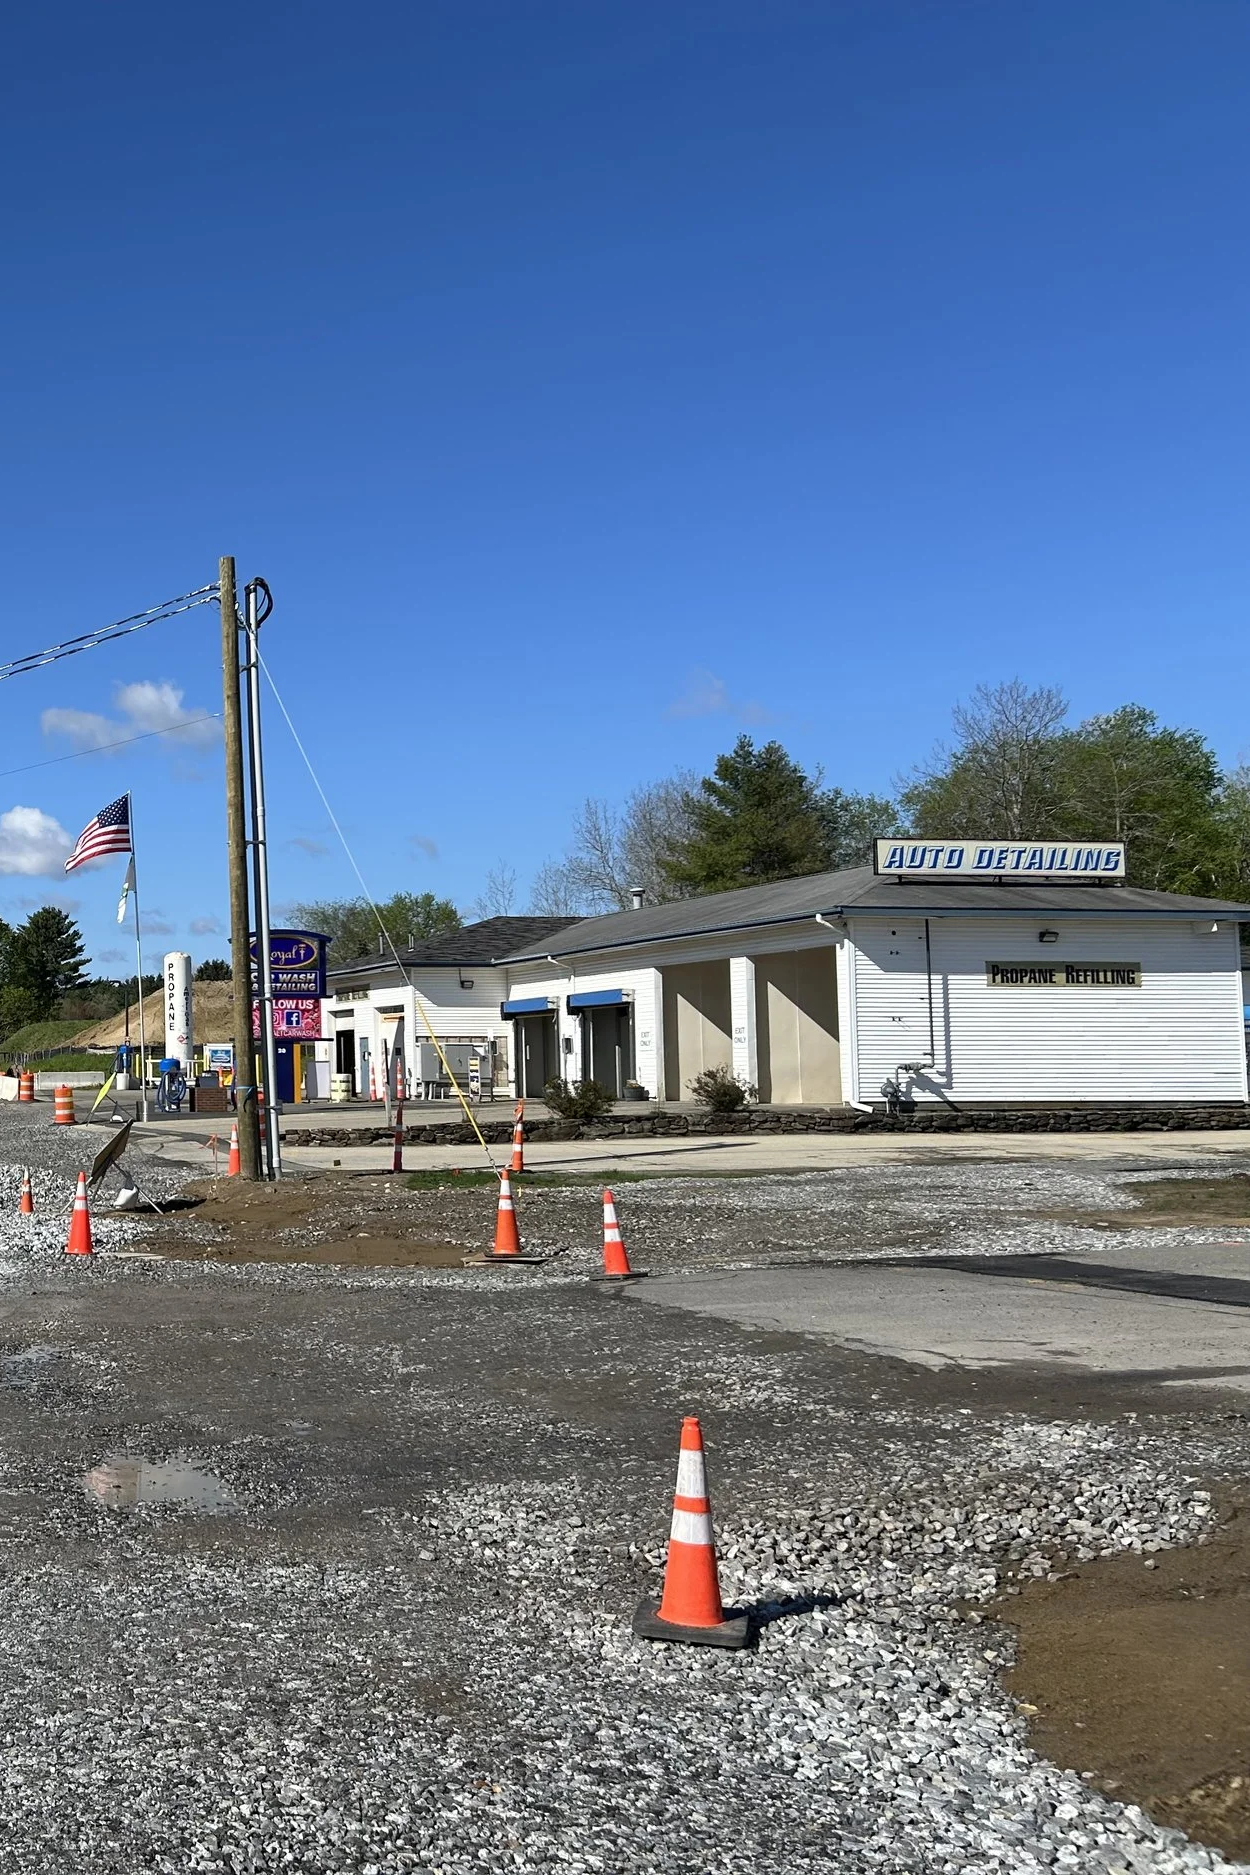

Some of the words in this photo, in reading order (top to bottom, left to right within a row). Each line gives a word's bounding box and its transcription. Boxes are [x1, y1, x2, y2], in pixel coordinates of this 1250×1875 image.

[883, 845, 964, 869] AUTO
[972, 845, 1121, 872] DETAILING
[269, 945, 298, 966] oyal
[278, 973, 316, 983] WASH
[251, 983, 258, 991] &
[271, 983, 316, 991] ETAILING
[253, 1000, 297, 1009] FLOW
[298, 1000, 314, 1009] US
